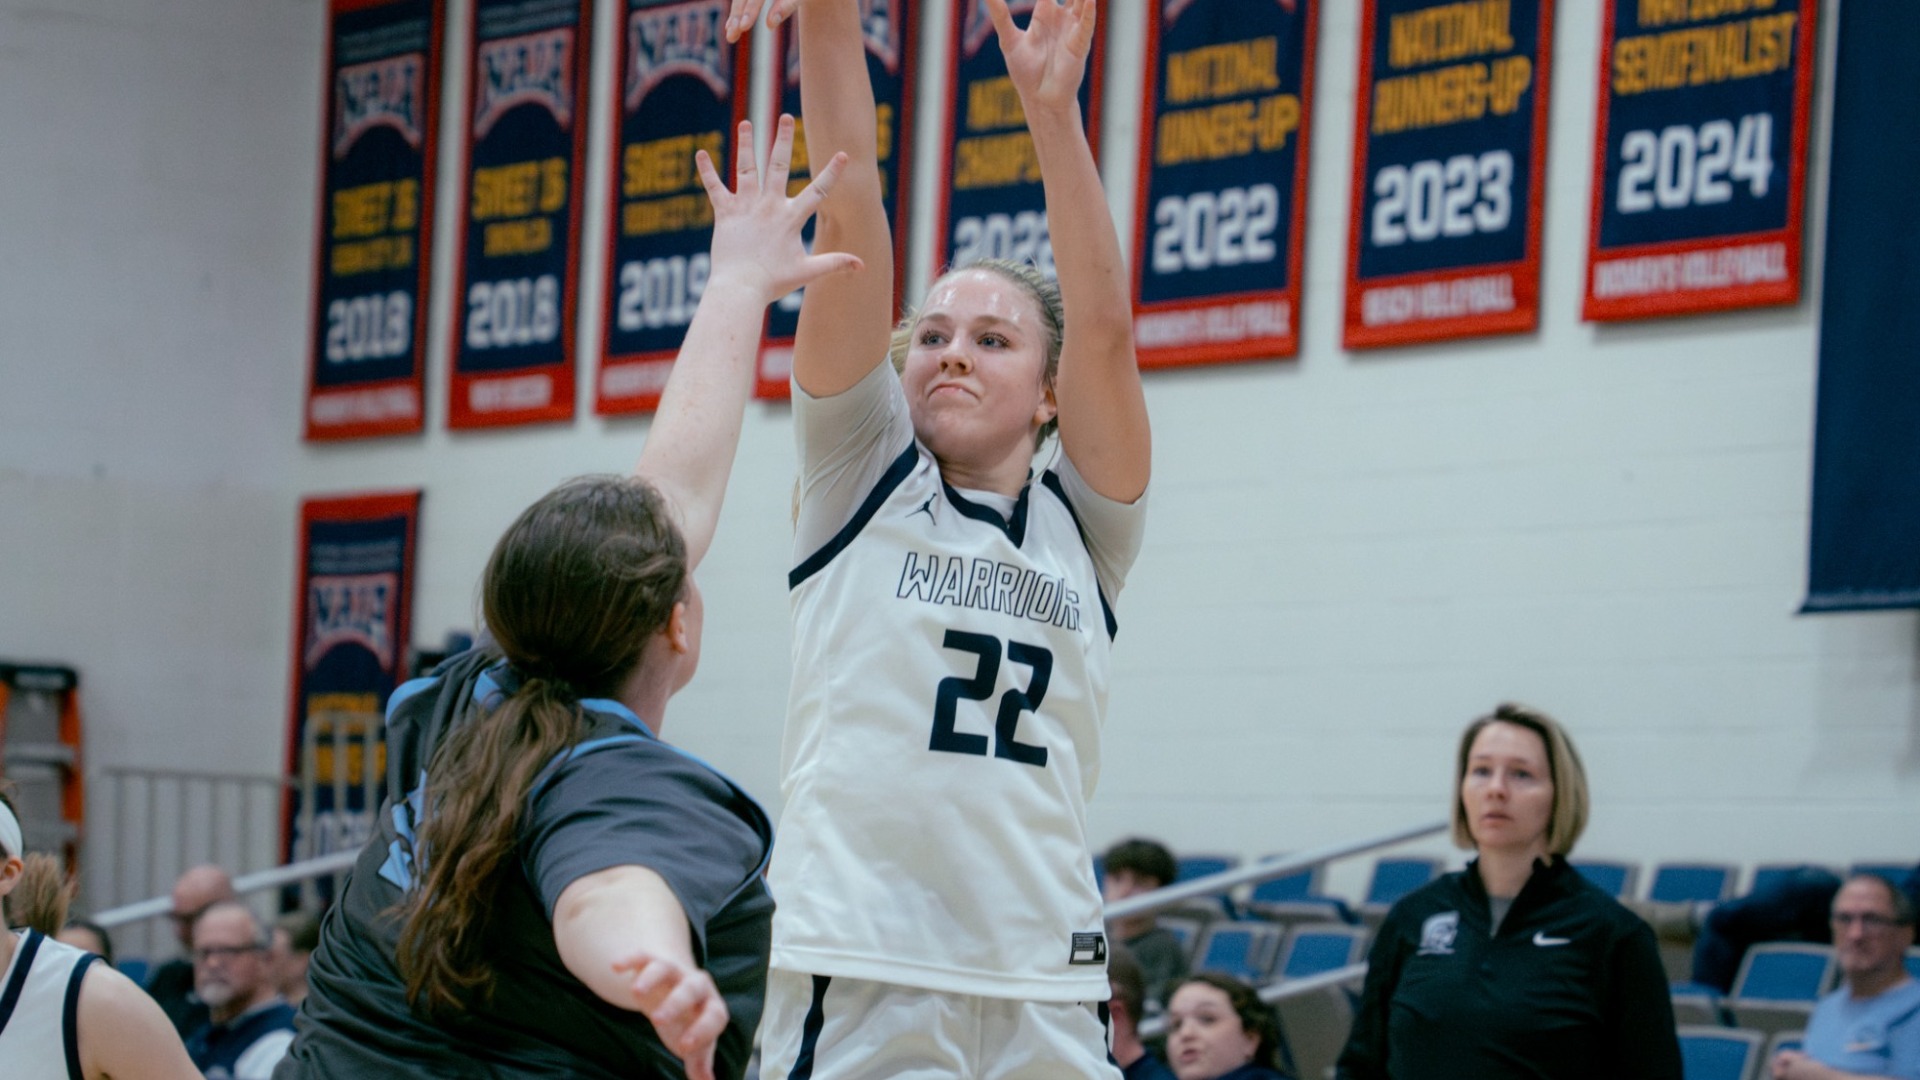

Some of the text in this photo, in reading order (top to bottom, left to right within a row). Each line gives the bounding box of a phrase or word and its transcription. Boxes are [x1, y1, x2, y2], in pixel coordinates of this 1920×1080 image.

[1389, 1, 1514, 68] NATIONAL
[1371, 149, 1514, 246] 2023
[1616, 112, 1773, 213] 2024
[1152, 183, 1279, 274] 2022
[465, 274, 560, 350] 2018
[929, 628, 1054, 768] 22
